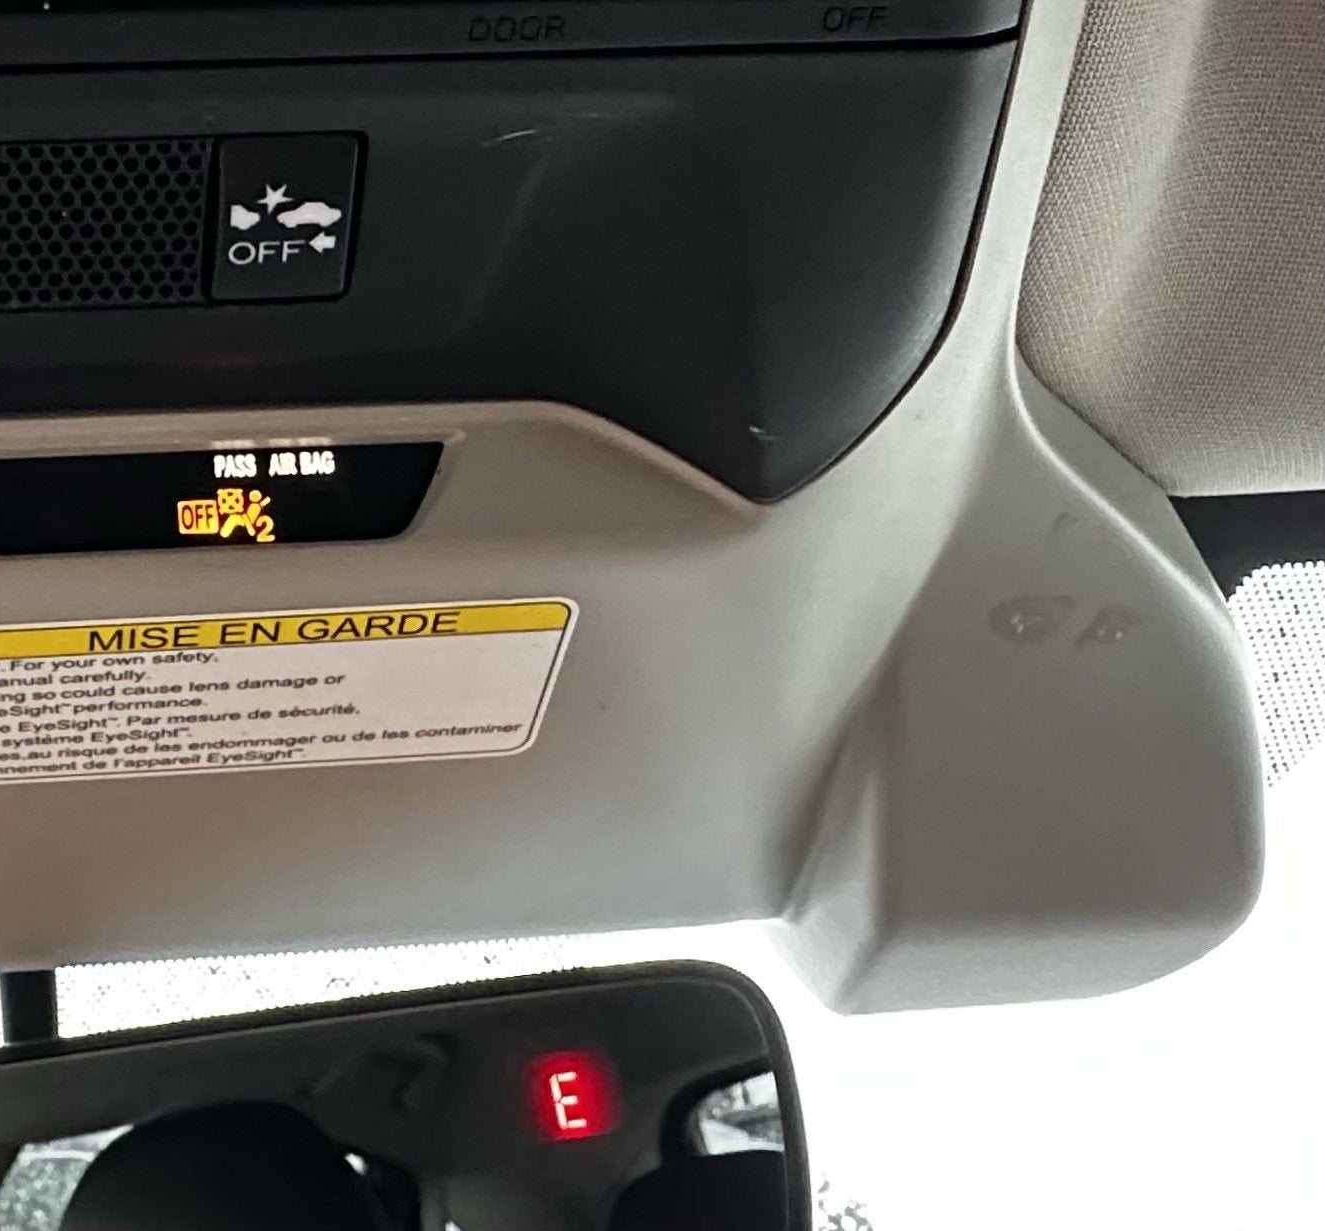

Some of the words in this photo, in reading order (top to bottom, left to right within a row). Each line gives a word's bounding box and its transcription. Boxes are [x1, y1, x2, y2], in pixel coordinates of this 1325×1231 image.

[467, 15, 567, 42] DOOR
[823, 5, 889, 32] OFF
[228, 240, 307, 266] OFF
[213, 453, 257, 478] PASS
[269, 452, 298, 477] AIR
[299, 451, 335, 476] BAG
[181, 504, 215, 530] OFF
[256, 515, 276, 543] 2
[88, 625, 201, 652] MISE
[219, 621, 281, 645] EN
[297, 611, 461, 640] GARDE
[10, 660, 44, 672] For
[51, 658, 97, 672] your
[102, 654, 145, 667] own
[32, 690, 56, 701] so
[60, 685, 116, 700] could
[122, 683, 182, 696] cause
[188, 680, 230, 693] lens
[237, 675, 319, 691] damage
[324, 674, 346, 686] or
[127, 716, 161, 728] Par
[167, 711, 242, 725] mesure
[247, 708, 272, 721] de
[57, 744, 118, 759] risque
[123, 742, 149, 755] de
[188, 733, 317, 752] endommager
[322, 732, 347, 744] ou
[351, 729, 377, 742] de
[415, 722, 523, 739] contaminer
[82, 757, 107, 770] de
[549, 1070, 587, 1130] E
